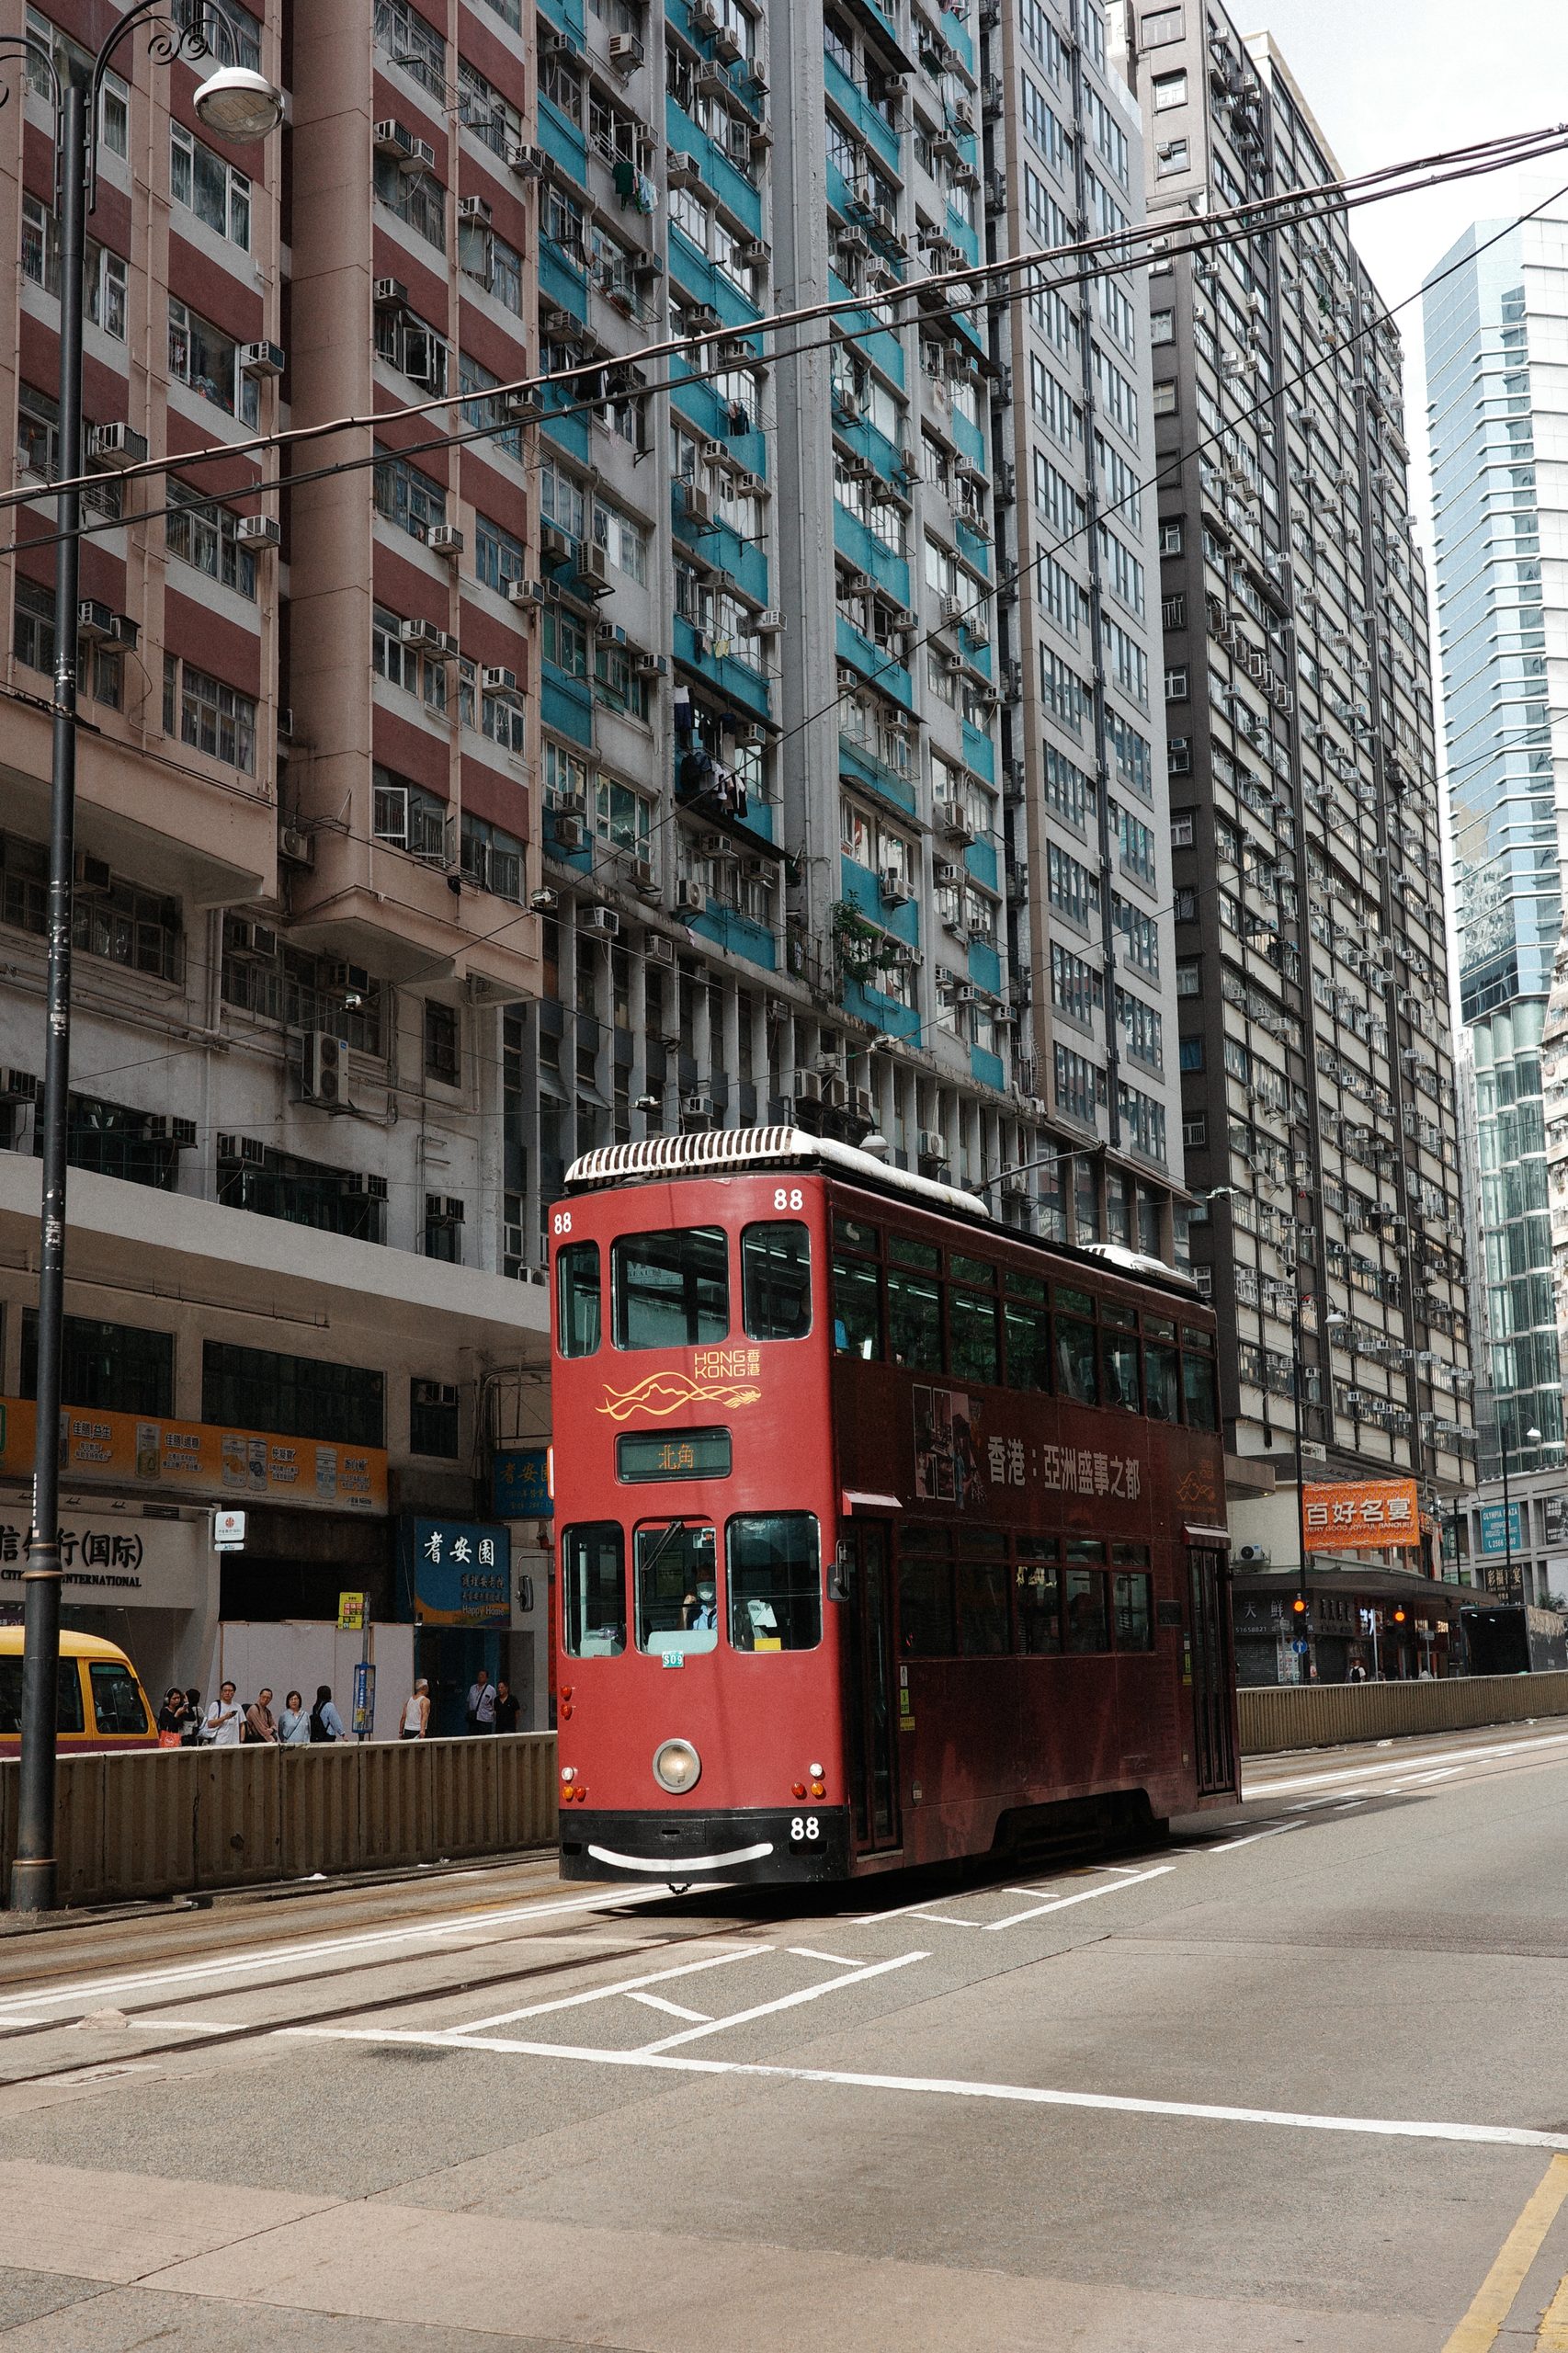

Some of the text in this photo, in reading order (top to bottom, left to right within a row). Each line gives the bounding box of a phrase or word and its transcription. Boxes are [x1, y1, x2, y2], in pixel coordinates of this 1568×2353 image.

[774, 1188, 804, 1211] 88
[553, 1211, 572, 1235] 88
[695, 1350, 745, 1366] HONG
[695, 1364, 746, 1380] KONG
[658, 1443, 695, 1471] 北角
[1305, 1497, 1412, 1526] 百好名宴
[1483, 1510, 1502, 1520] OLYMPIA
[1348, 1523, 1377, 1531] JOYFUL
[1379, 1521, 1415, 1529] BANQUET
[424, 1531, 494, 1567] 耆安園
[1, 1569, 142, 1588] CITI NTERNATIONAL
[462, 1605, 505, 1618] Happy Home
[664, 1654, 683, 1665] S09
[790, 1816, 820, 1841] 88
